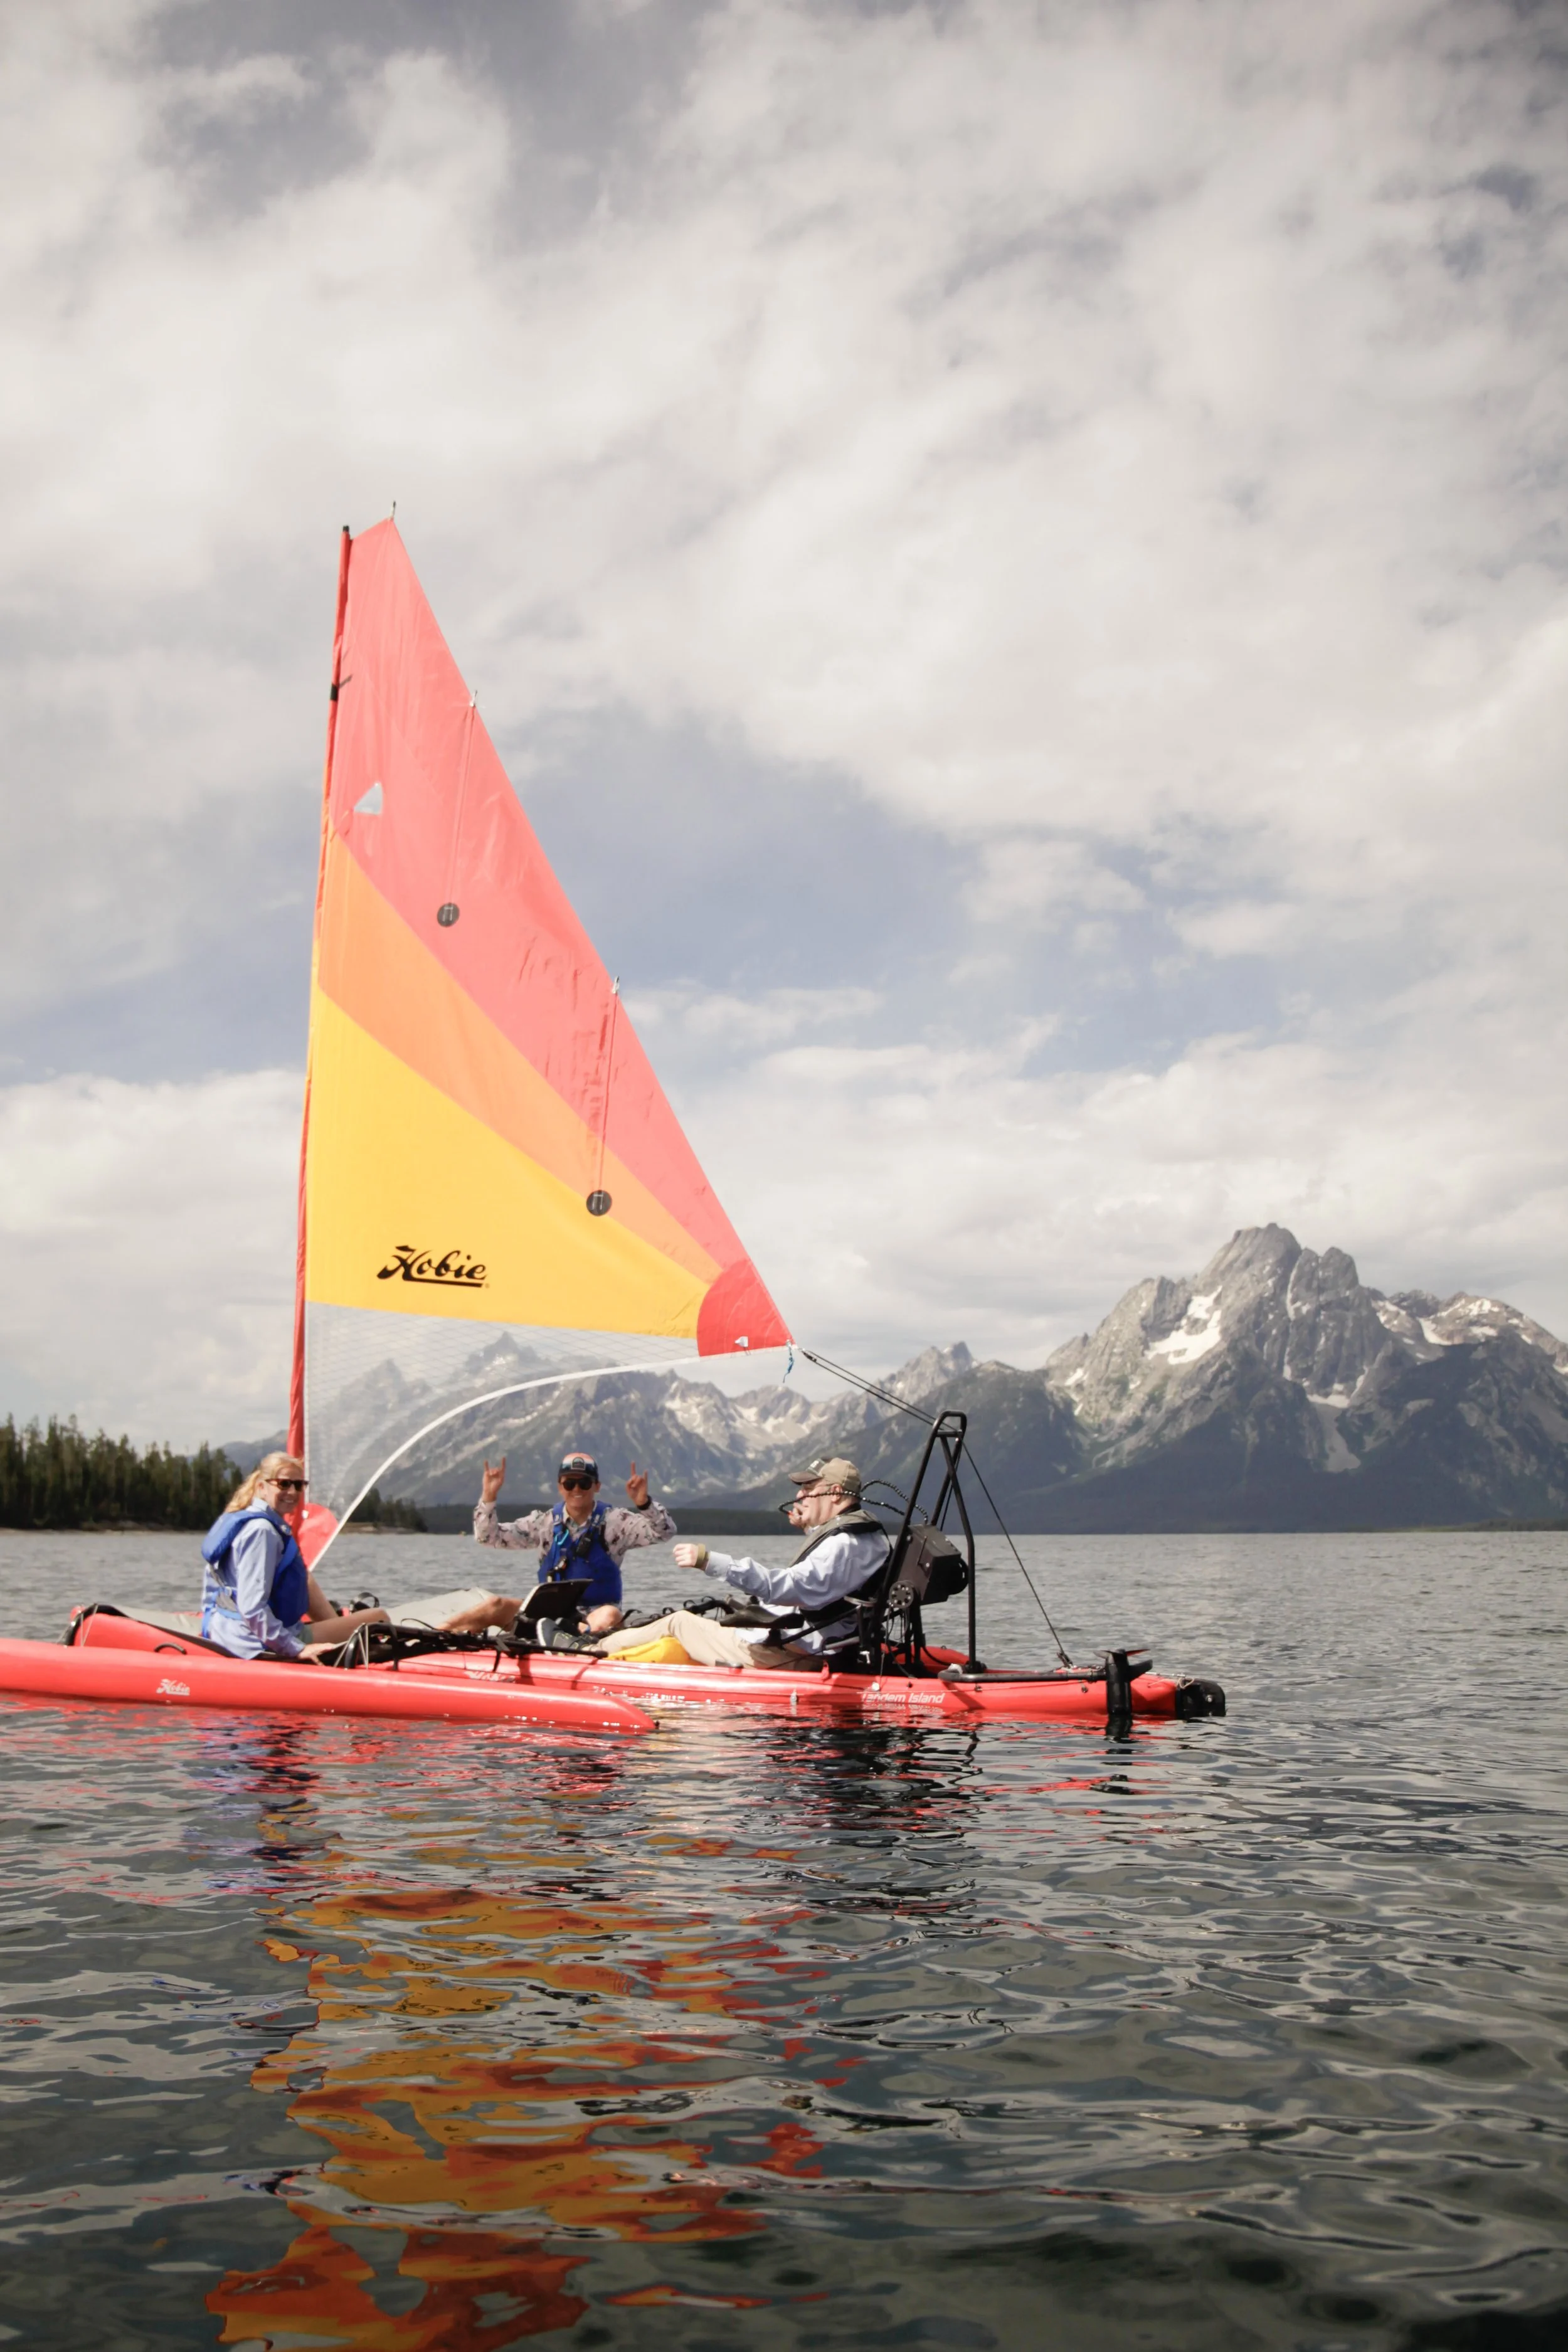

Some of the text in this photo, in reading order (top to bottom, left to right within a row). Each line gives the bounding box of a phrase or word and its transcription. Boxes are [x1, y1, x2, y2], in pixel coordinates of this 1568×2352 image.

[376, 1245, 487, 1288] Hobie
[156, 1678, 190, 1696] Hobie
[908, 1692, 945, 1703] Island
